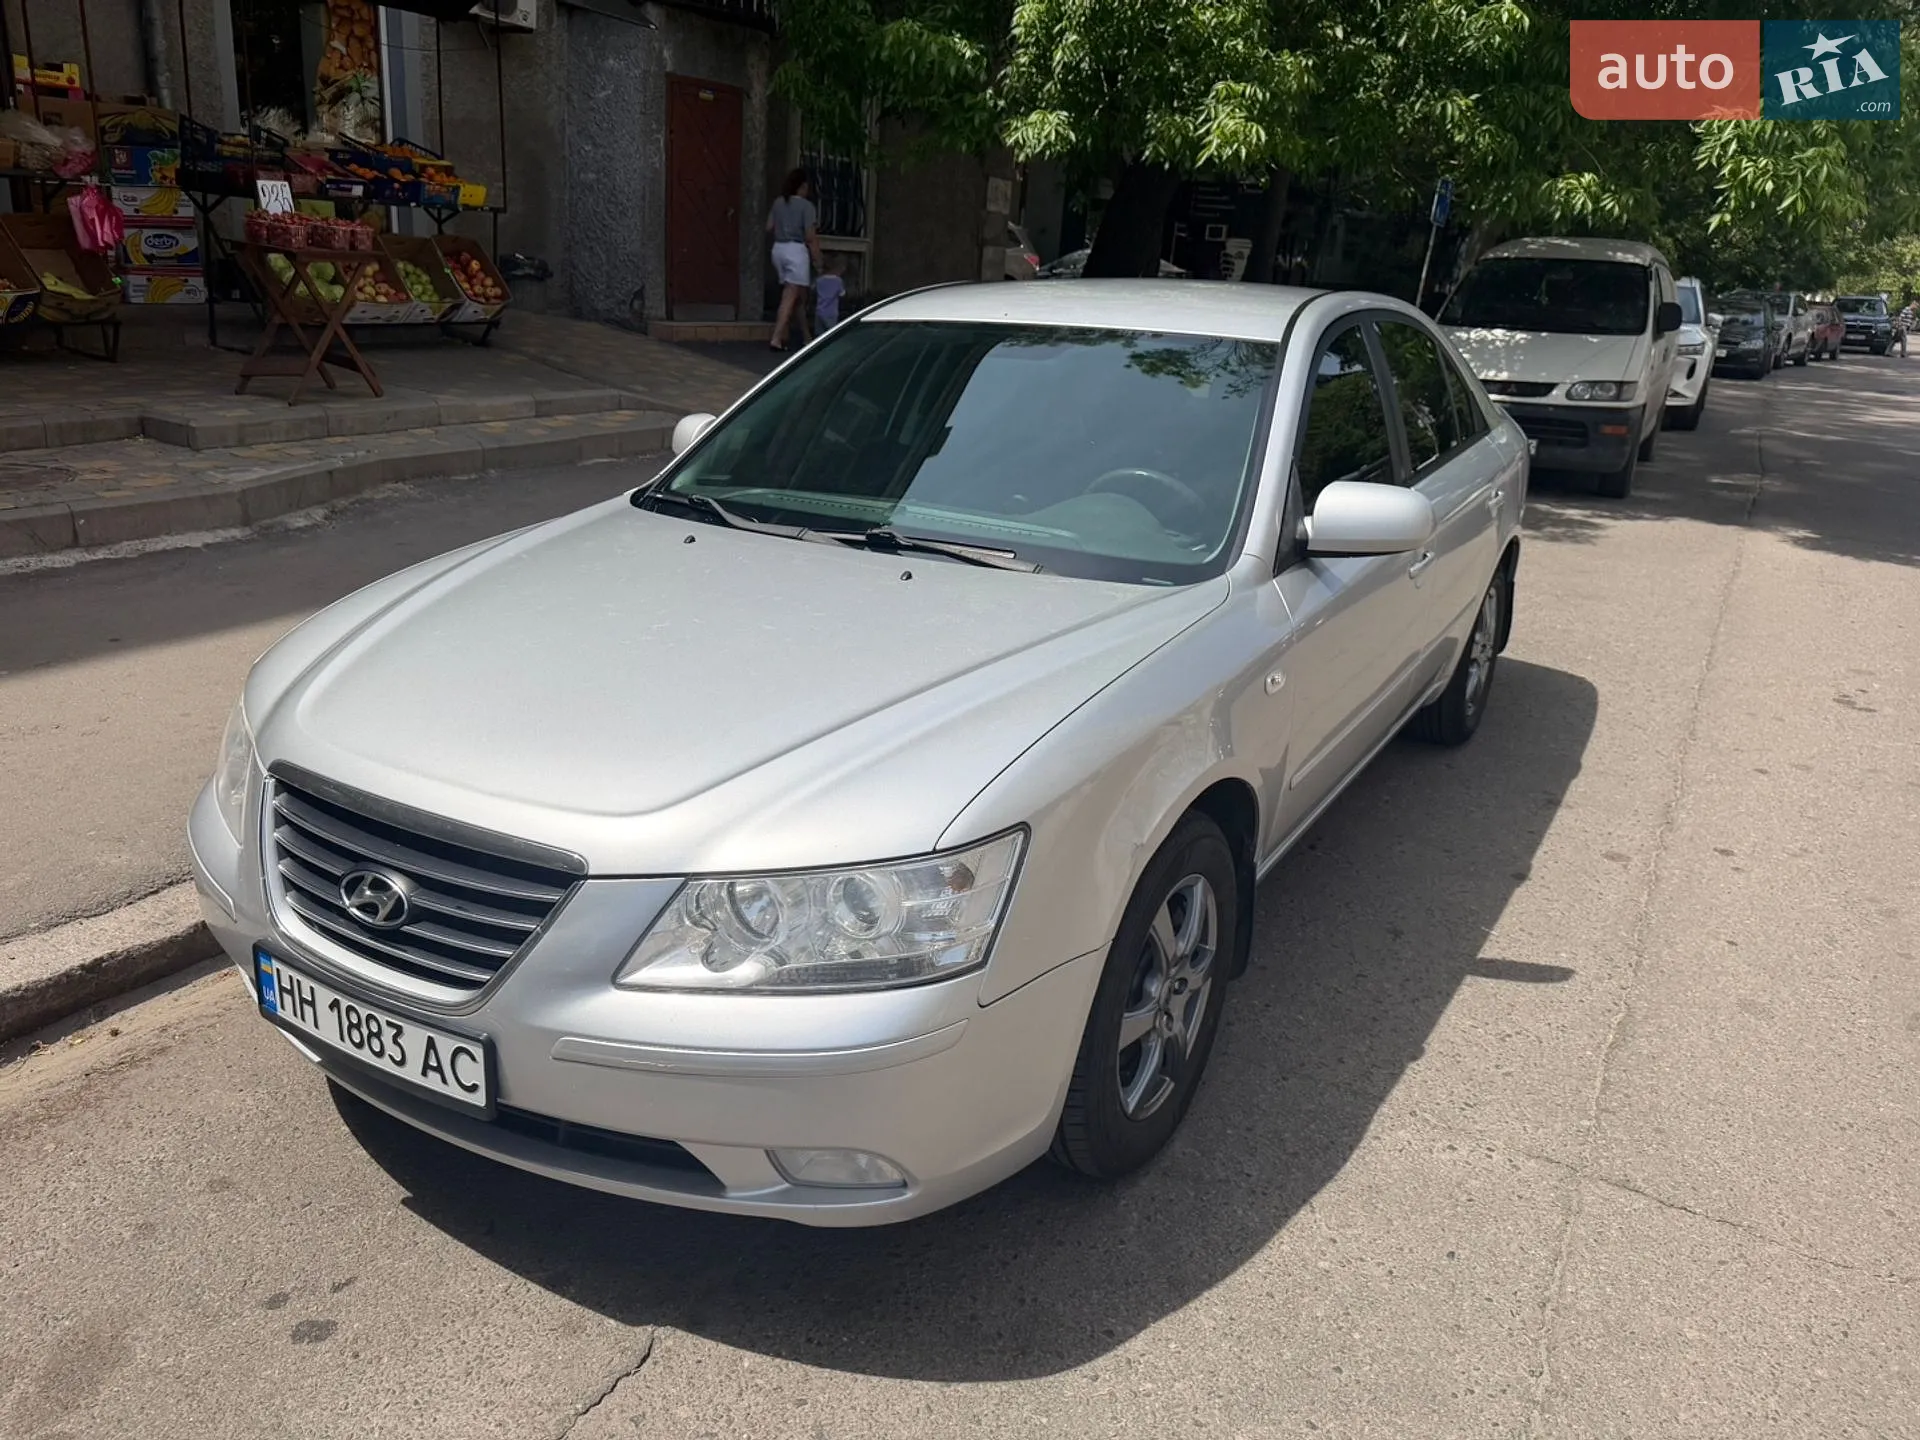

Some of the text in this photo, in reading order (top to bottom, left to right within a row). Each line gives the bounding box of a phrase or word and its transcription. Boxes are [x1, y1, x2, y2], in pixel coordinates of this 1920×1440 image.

[147, 235, 176, 247] derby
[262, 985, 276, 1004] UA
[276, 967, 480, 1094] HH 1883 AC
